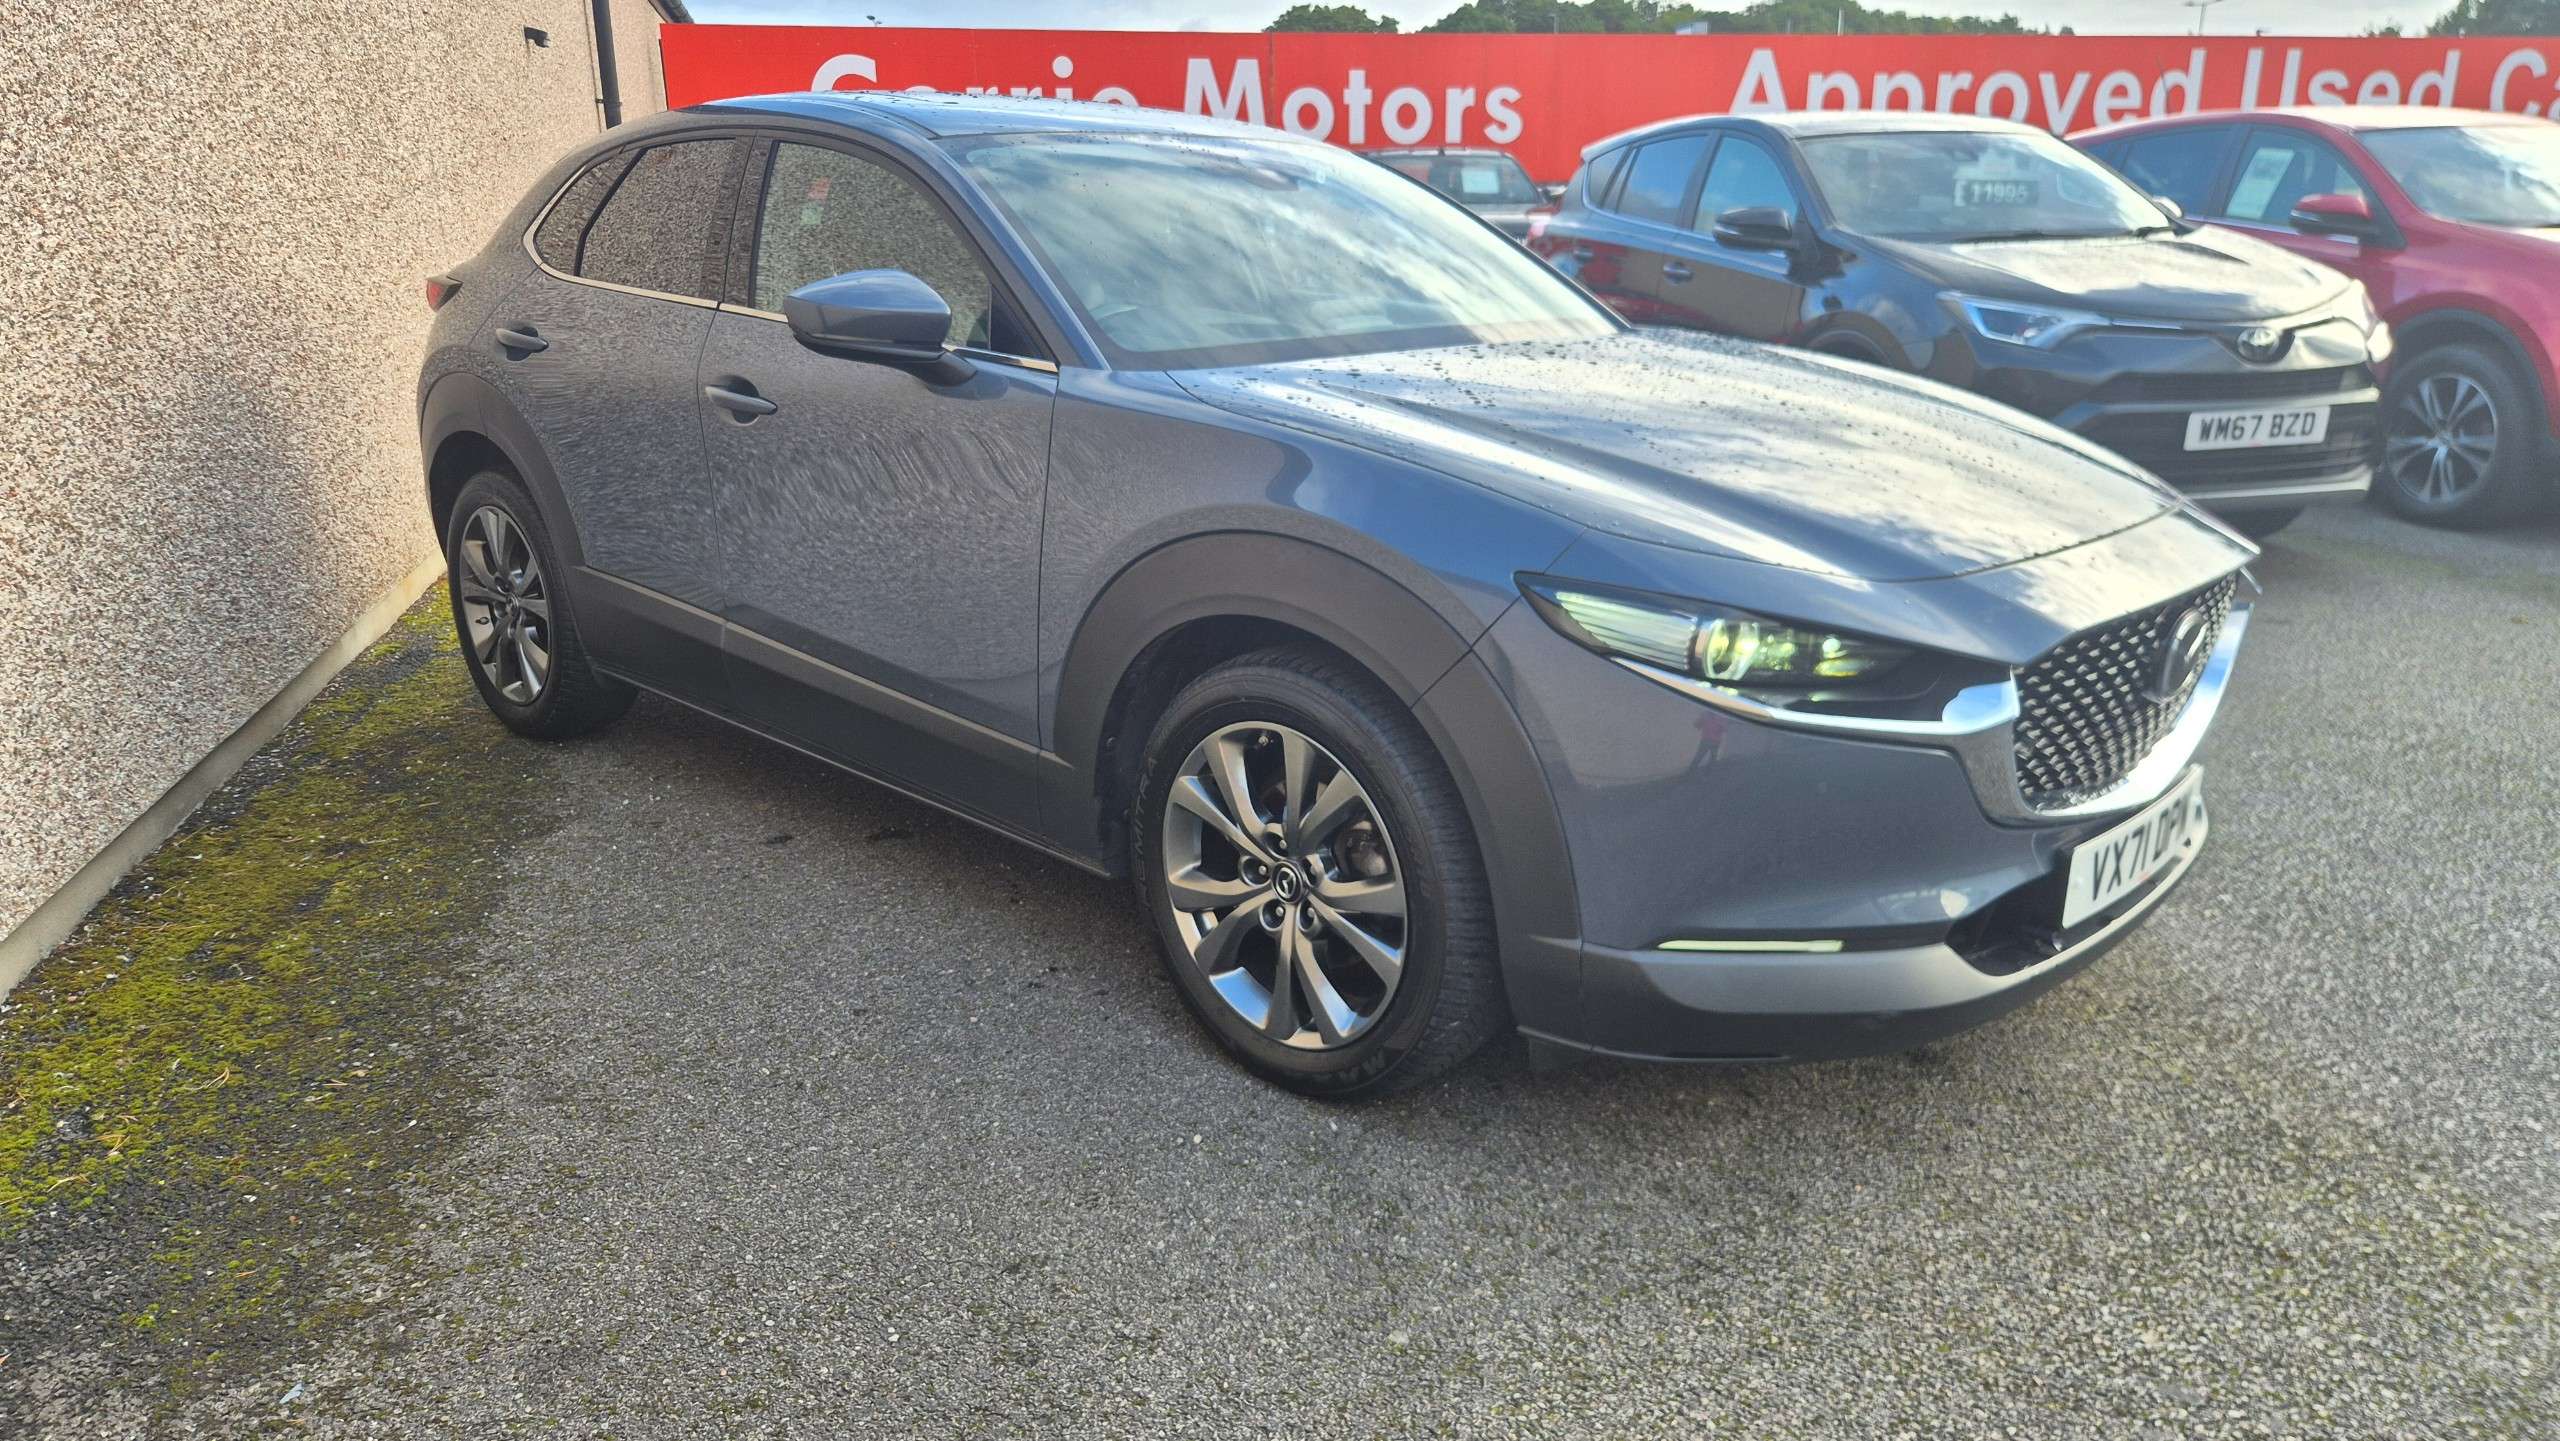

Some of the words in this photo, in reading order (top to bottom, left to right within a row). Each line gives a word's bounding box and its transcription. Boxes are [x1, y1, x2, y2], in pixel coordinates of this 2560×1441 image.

[1183, 58, 1524, 144] Motors
[2240, 47, 2462, 113] Used
[2489, 48, 2560, 121] C
[2199, 414, 2263, 442] WM67
[2269, 411, 2316, 438] BZD
[2092, 821, 2152, 901] VX71
